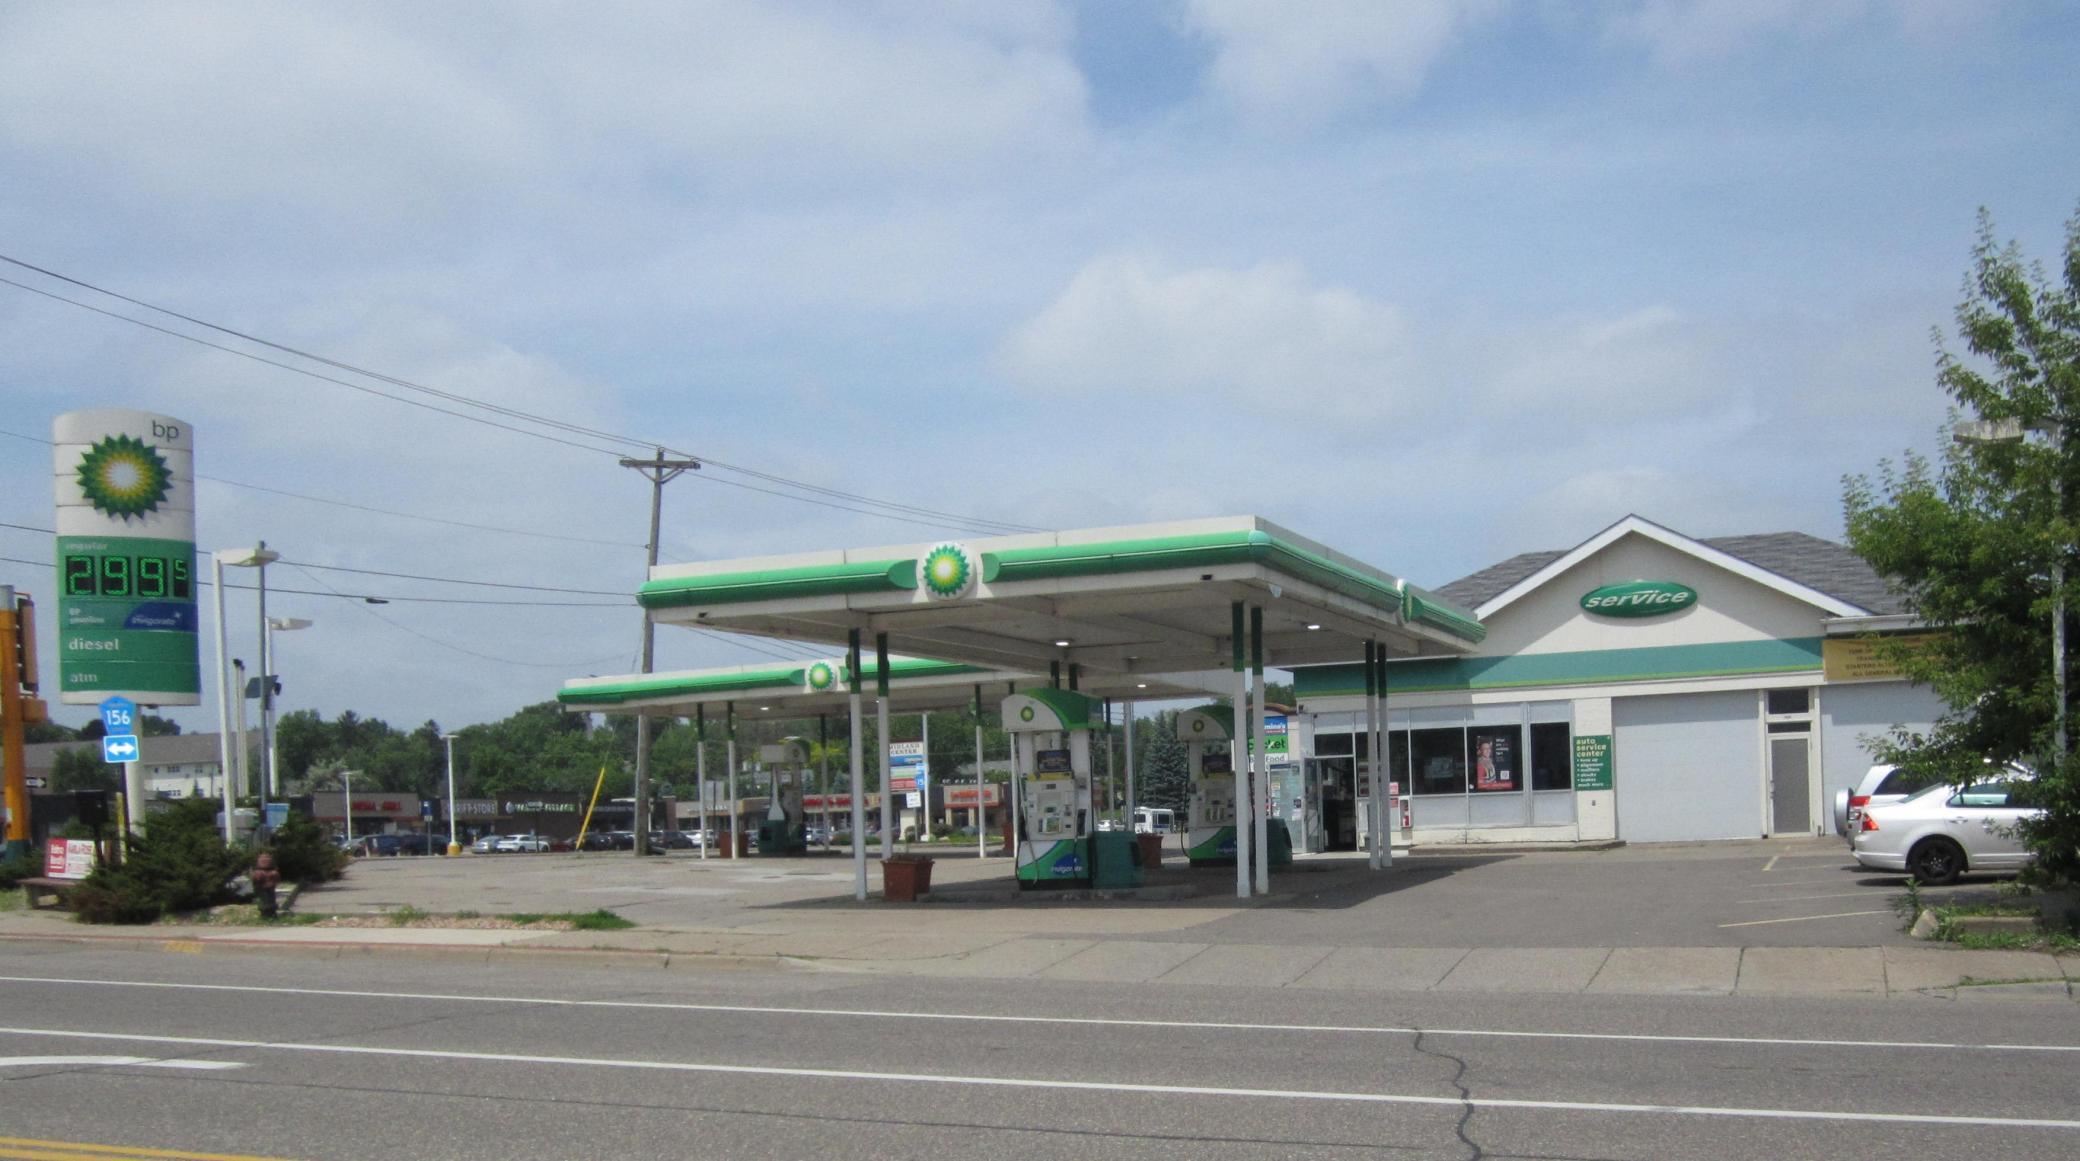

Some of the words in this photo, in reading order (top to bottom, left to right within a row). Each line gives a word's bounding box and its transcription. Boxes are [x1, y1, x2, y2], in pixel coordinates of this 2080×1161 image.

[152, 419, 179, 442] bp
[1585, 590, 1689, 608] service
[68, 638, 120, 650] diesel
[69, 672, 98, 683] atm
[106, 709, 131, 725] 156
[1576, 750, 1605, 758] center
